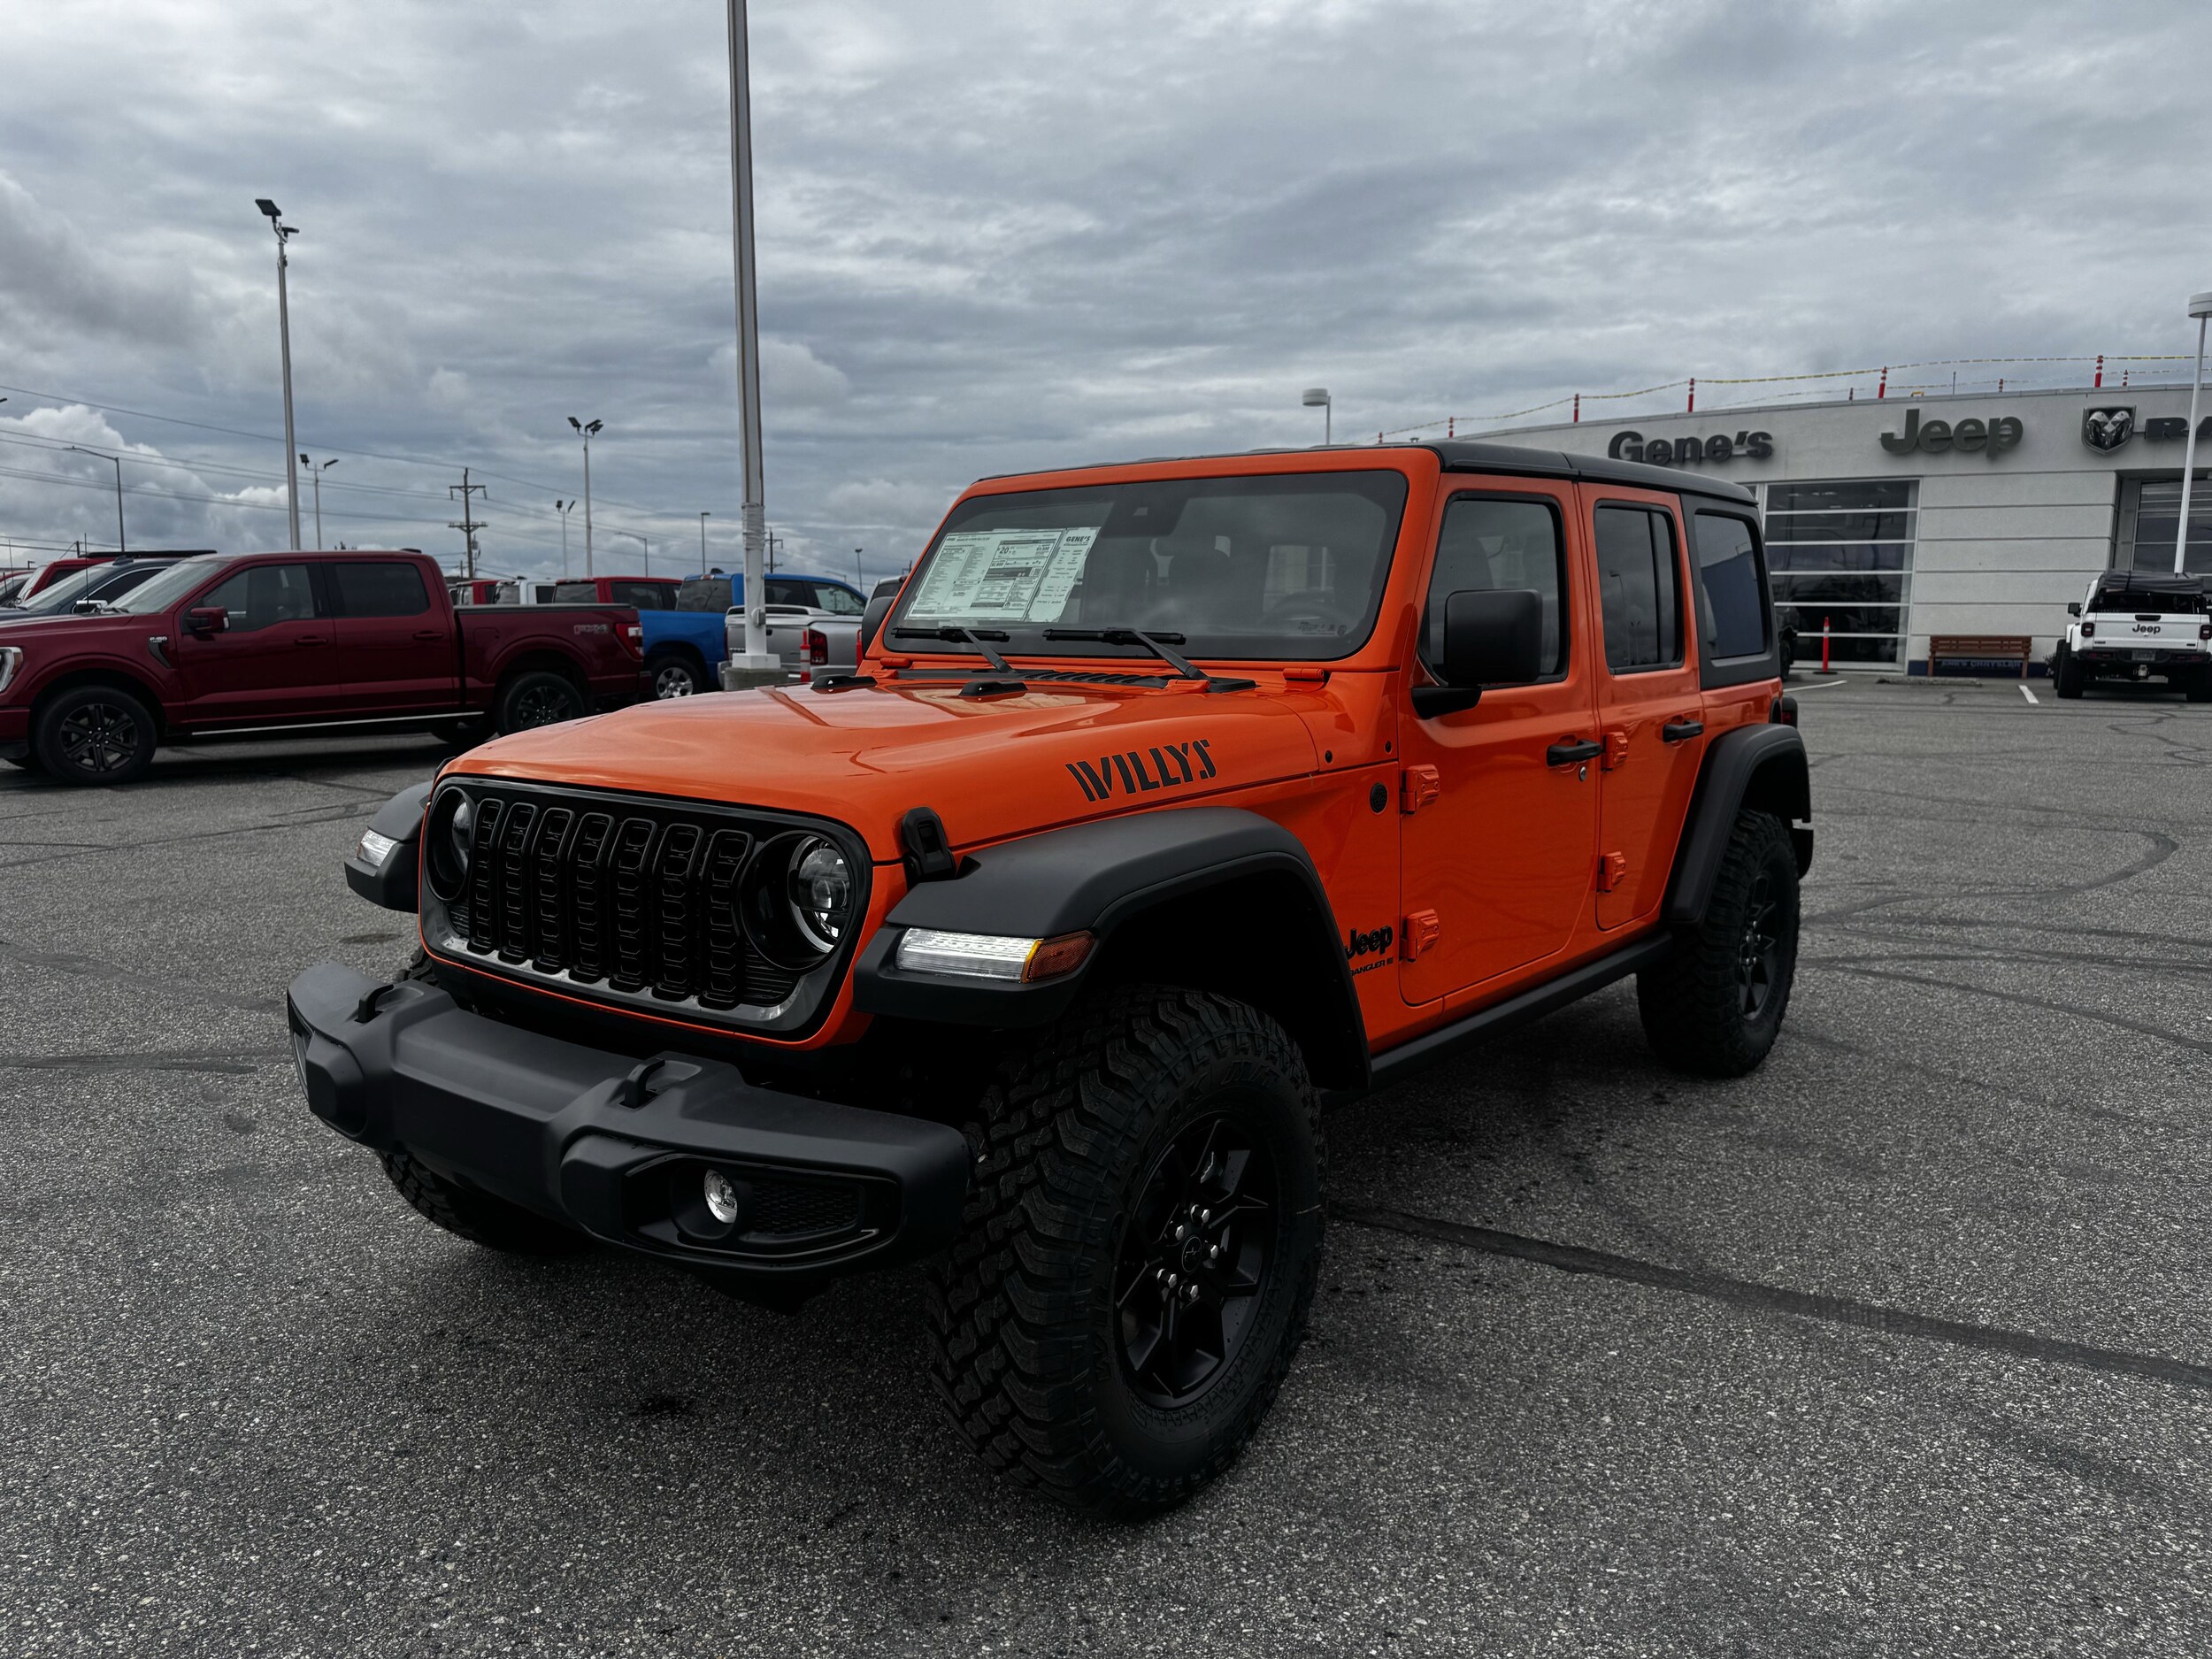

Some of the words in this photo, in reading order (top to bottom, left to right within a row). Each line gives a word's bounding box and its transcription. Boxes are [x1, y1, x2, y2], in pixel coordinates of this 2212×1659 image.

[1608, 431, 1773, 465] Gene's
[1880, 409, 2024, 459] Jeep
[2132, 624, 2161, 634] Jeep
[1065, 739, 1217, 802] WILLYS
[1344, 925, 1394, 960] Jeep
[1350, 960, 1386, 976] RANGLER
